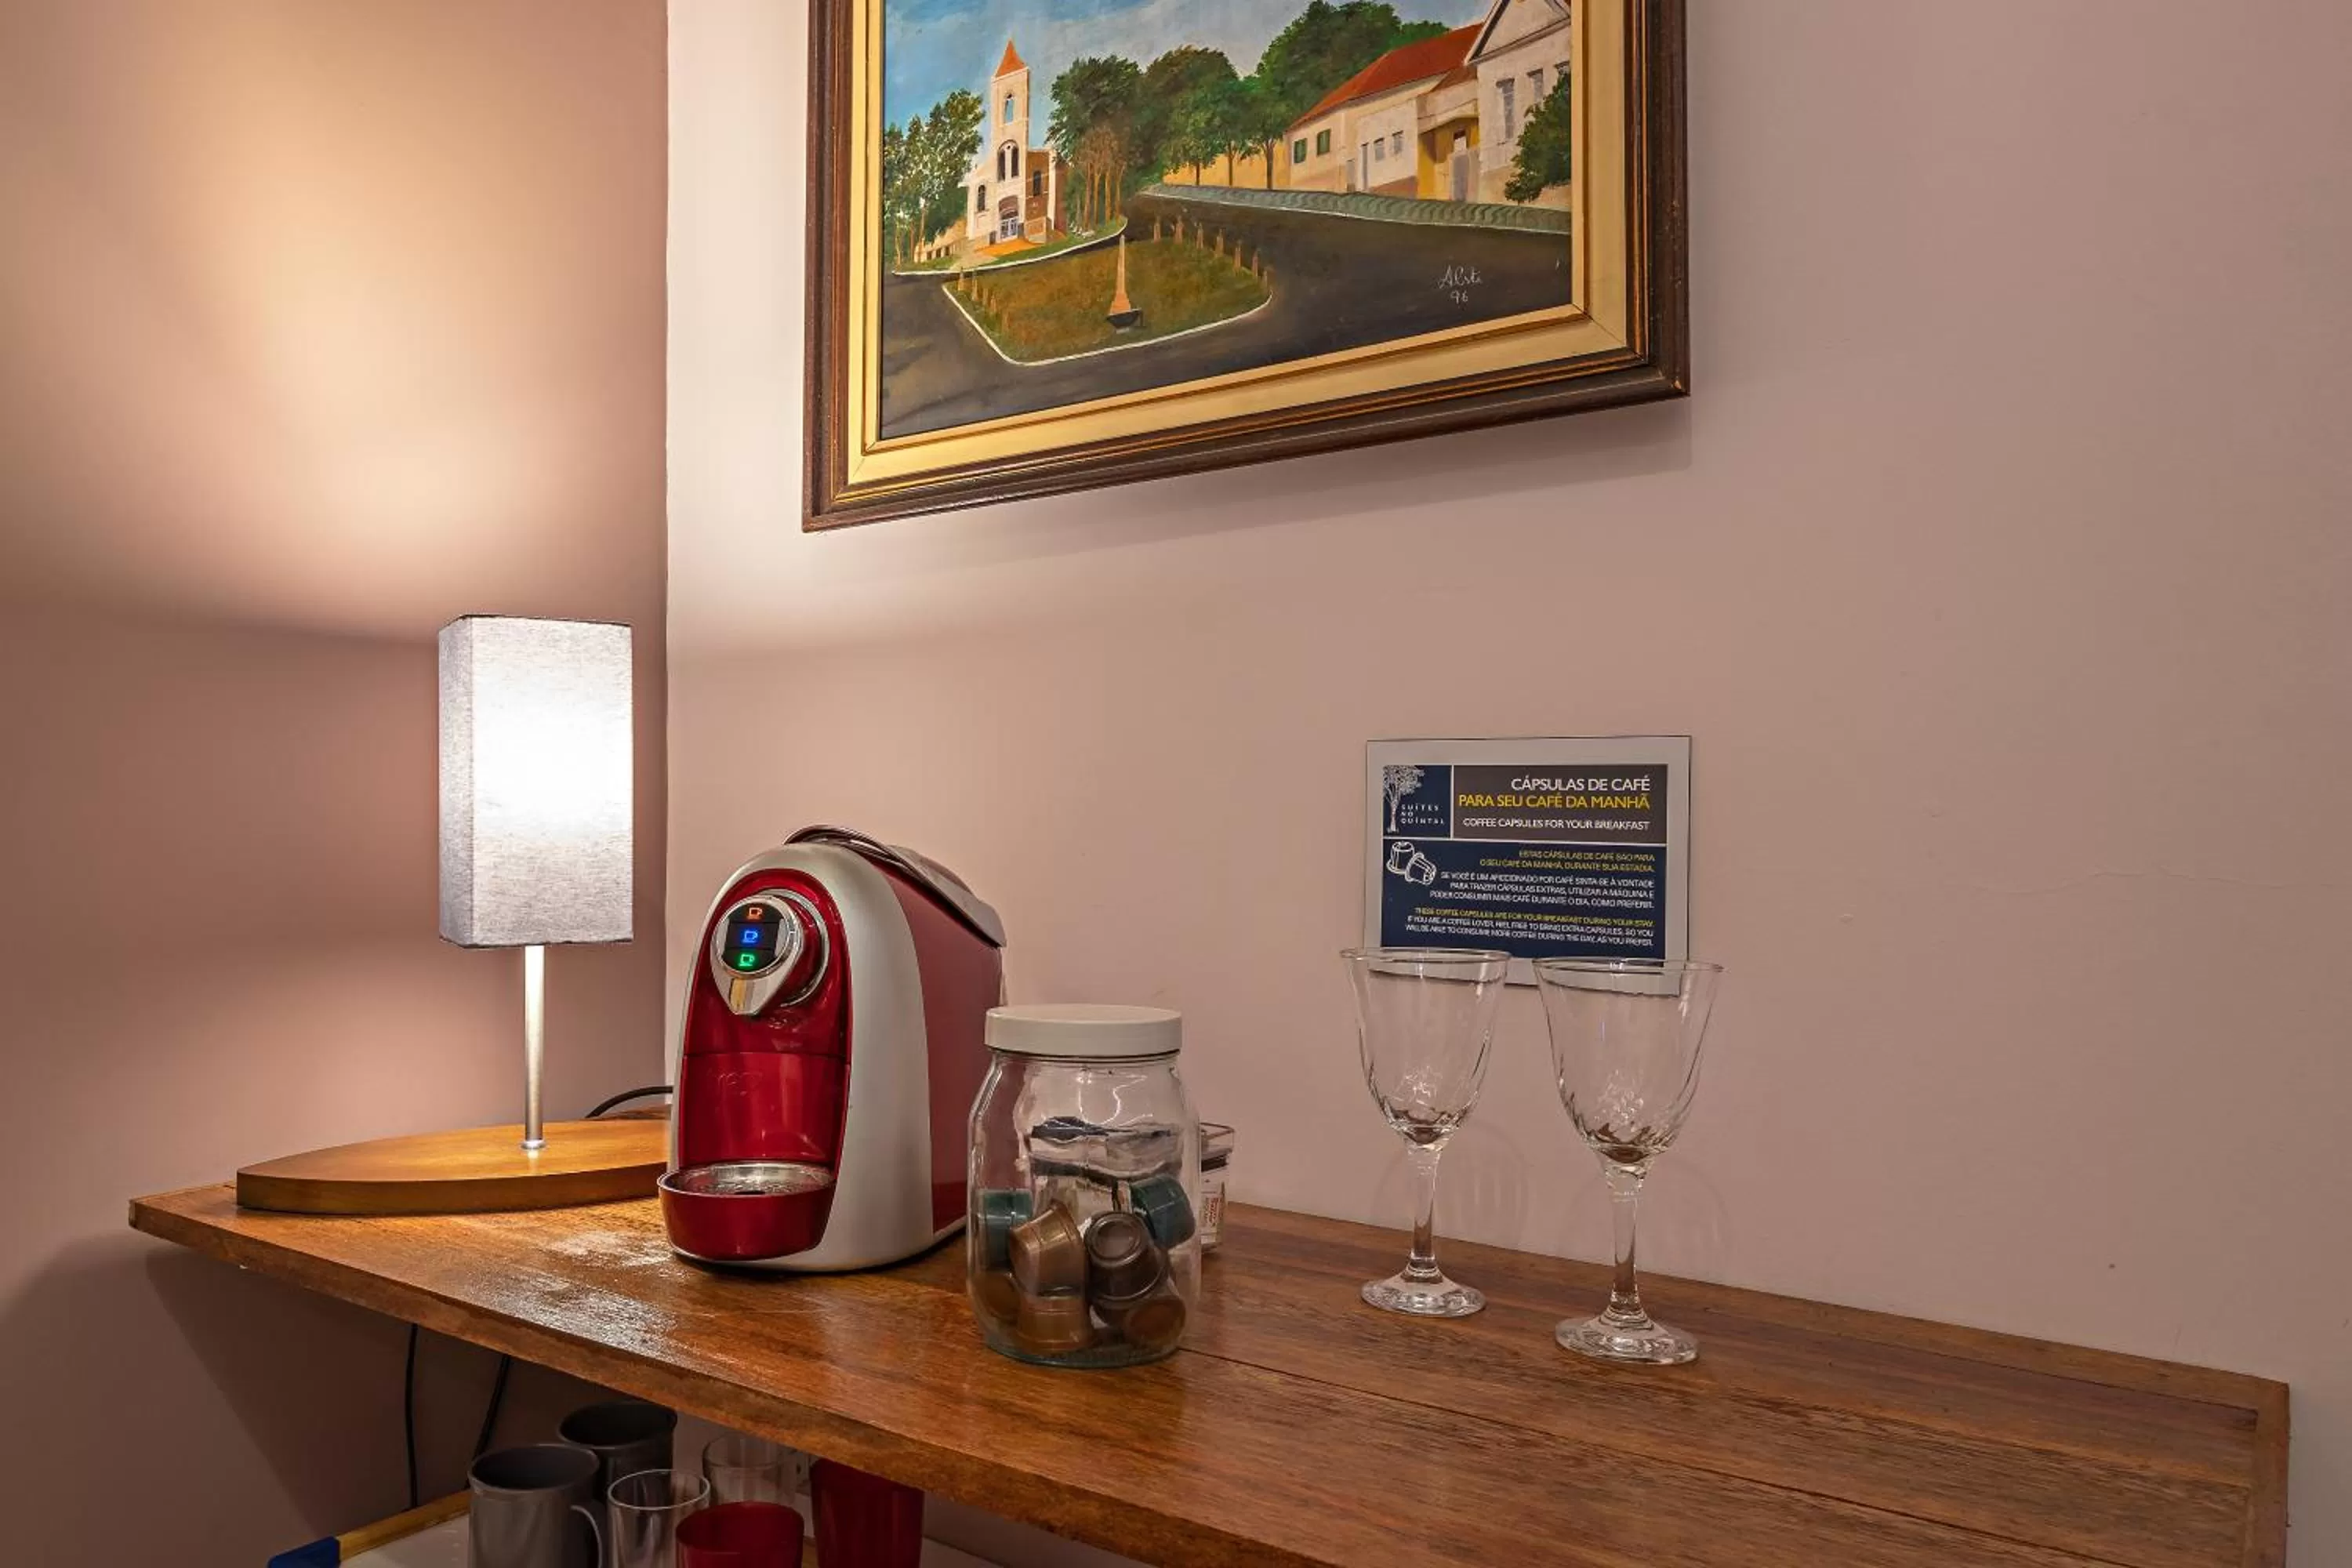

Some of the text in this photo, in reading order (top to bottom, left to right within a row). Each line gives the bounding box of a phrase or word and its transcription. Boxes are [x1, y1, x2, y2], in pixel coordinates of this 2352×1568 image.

[1511, 775, 1650, 791] CÁPSULAS DE CAFÉ
[1458, 792, 1650, 809] PARA SEU CAFÉ DA MANHÃ
[1463, 818, 1650, 830] COFFEE CAPSULES FOR YOUR BREAKFAST
[1564, 862, 1601, 870] DURANTE
[1476, 872, 1489, 880] UM
[1540, 875, 1555, 884] POR
[1617, 879, 1654, 888] VONTADE
[1532, 895, 1566, 905] DURANTE
[1584, 916, 1611, 925] DURING
[1637, 929, 1653, 938] YOU
